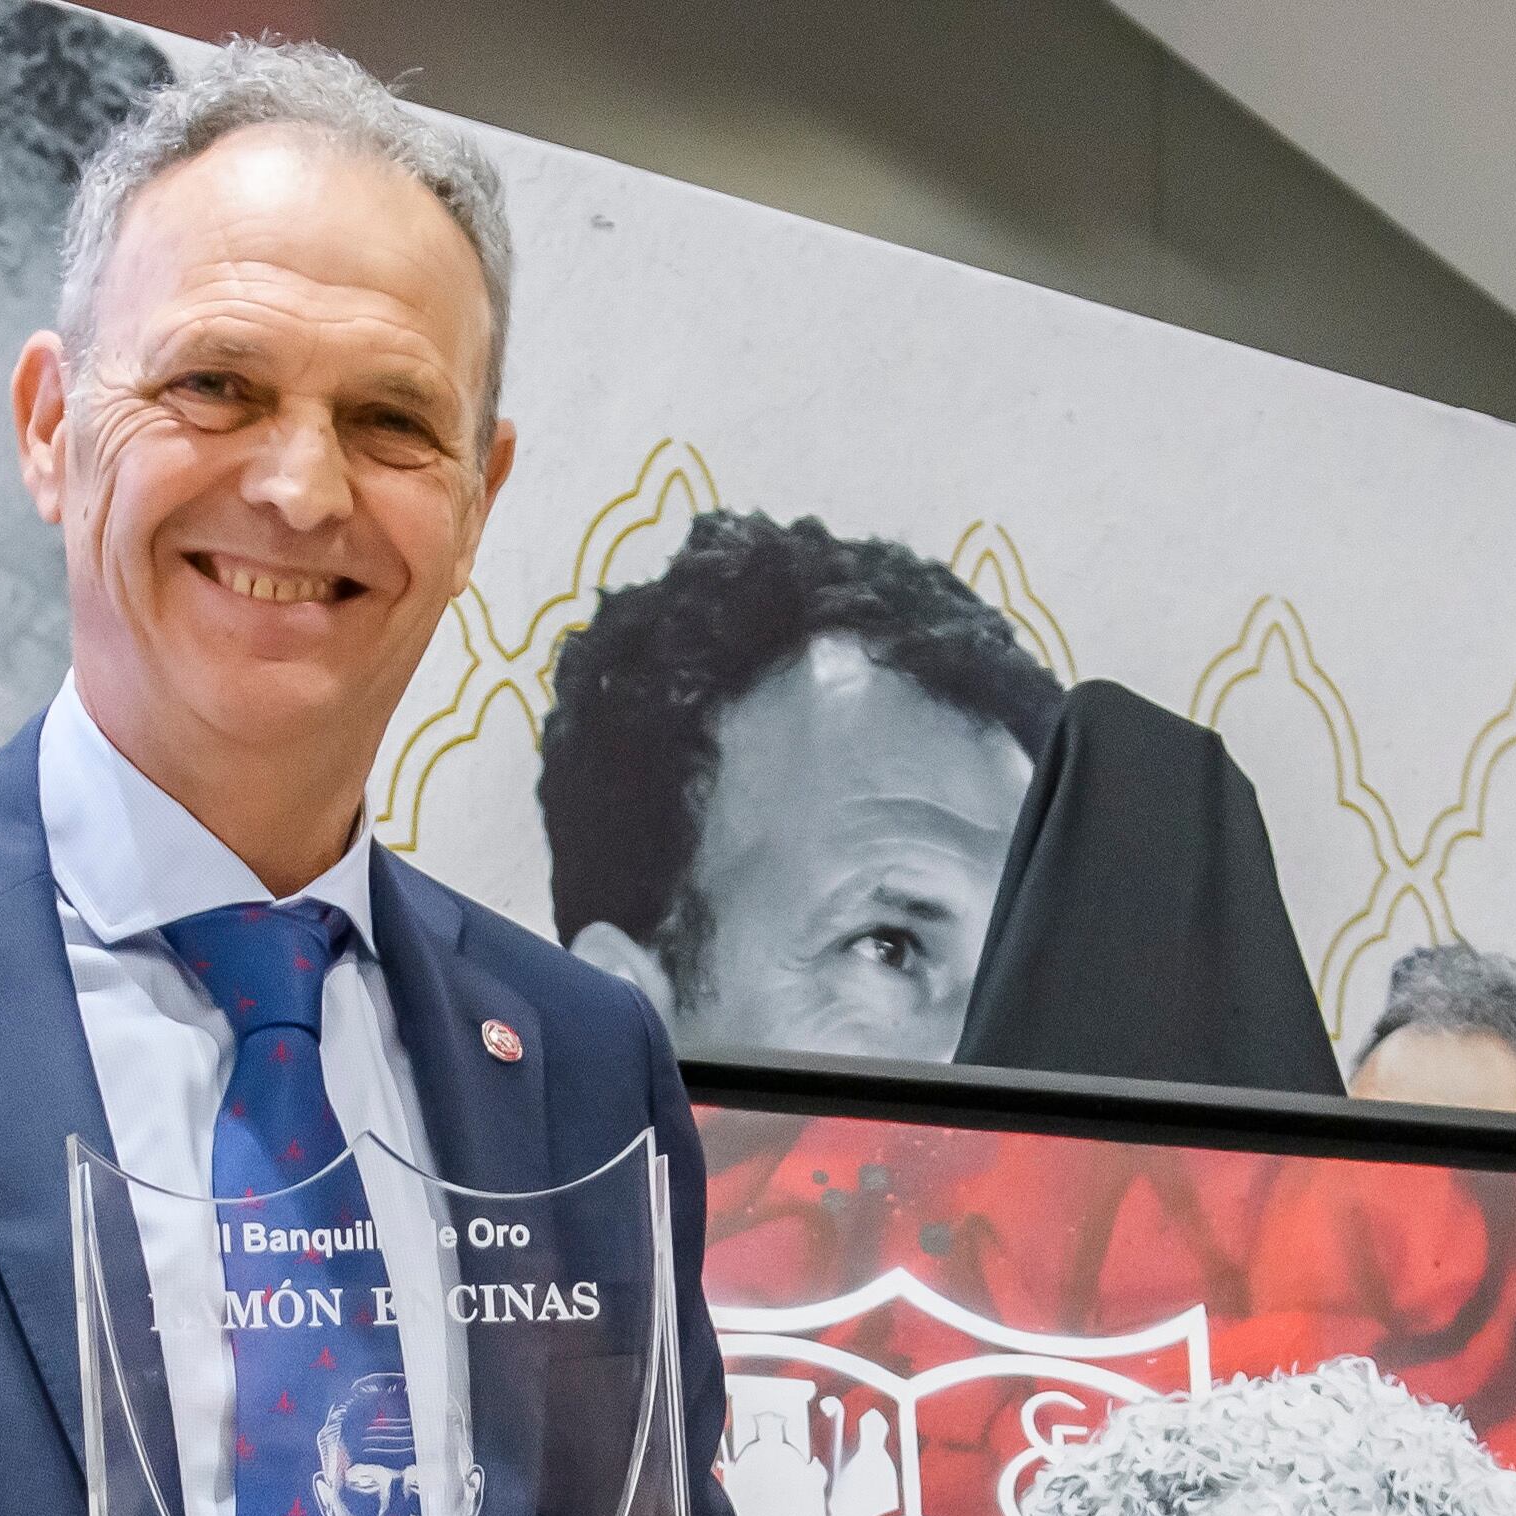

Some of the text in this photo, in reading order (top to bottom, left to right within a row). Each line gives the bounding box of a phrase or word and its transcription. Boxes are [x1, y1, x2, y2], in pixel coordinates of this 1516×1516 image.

[242, 1220, 385, 1260] Banquill
[467, 1216, 530, 1249] Oro
[148, 1279, 602, 1331] MÓN ECINAS
